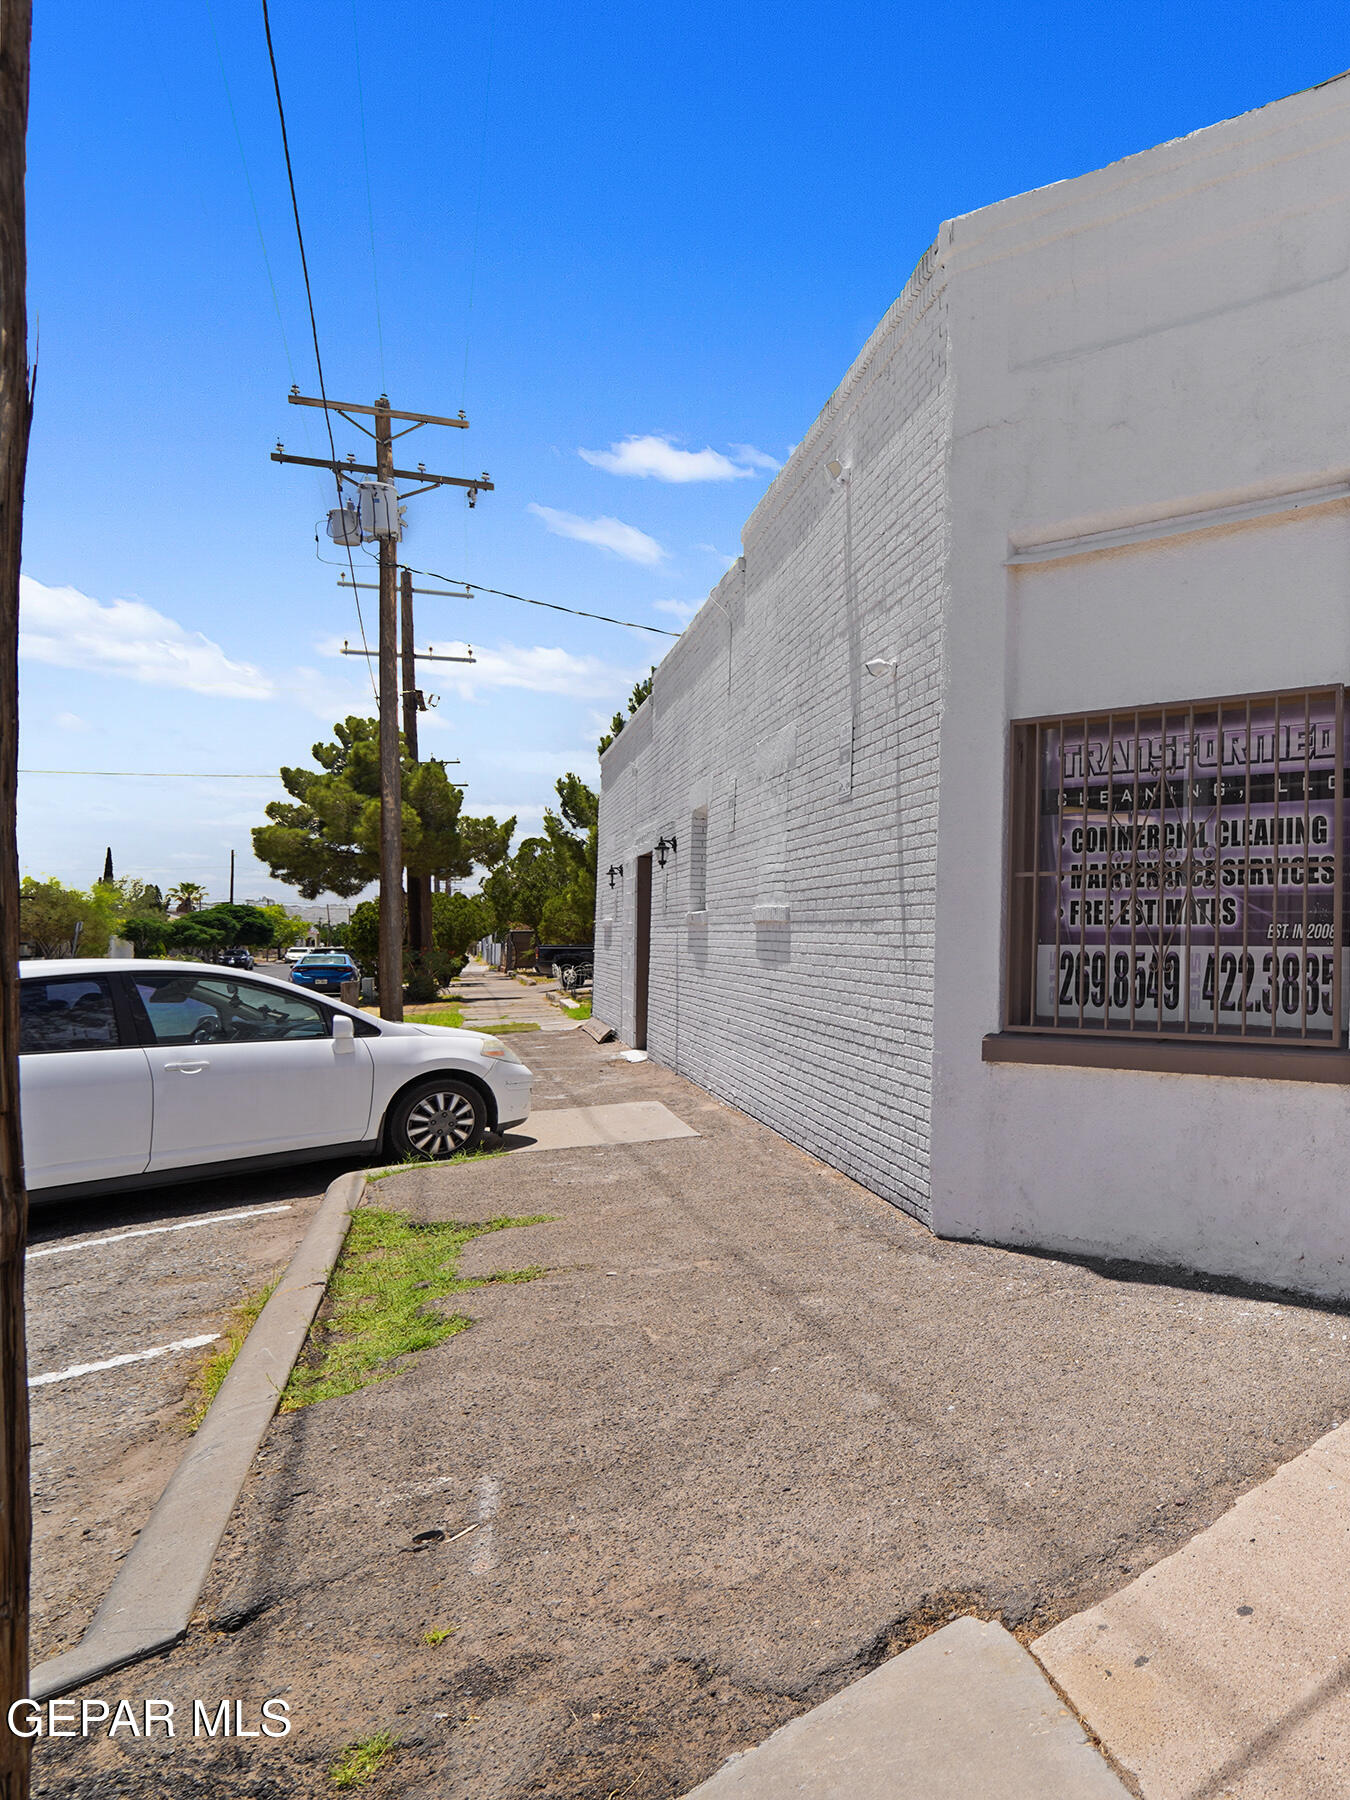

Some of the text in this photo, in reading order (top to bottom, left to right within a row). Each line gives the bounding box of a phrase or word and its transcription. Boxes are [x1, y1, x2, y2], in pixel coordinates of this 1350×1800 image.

[1058, 721, 1336, 779] TRANSFORMED
[1071, 815, 1328, 854] COMMERCIAL CLEANING
[1222, 855, 1336, 887] SERVICES
[1070, 897, 1237, 926] FREE ESTIMATES
[1267, 923, 1336, 940] EST. IN 2008
[1059, 950, 1180, 1011] 269.8549
[1202, 951, 1336, 1017] 422.3835
